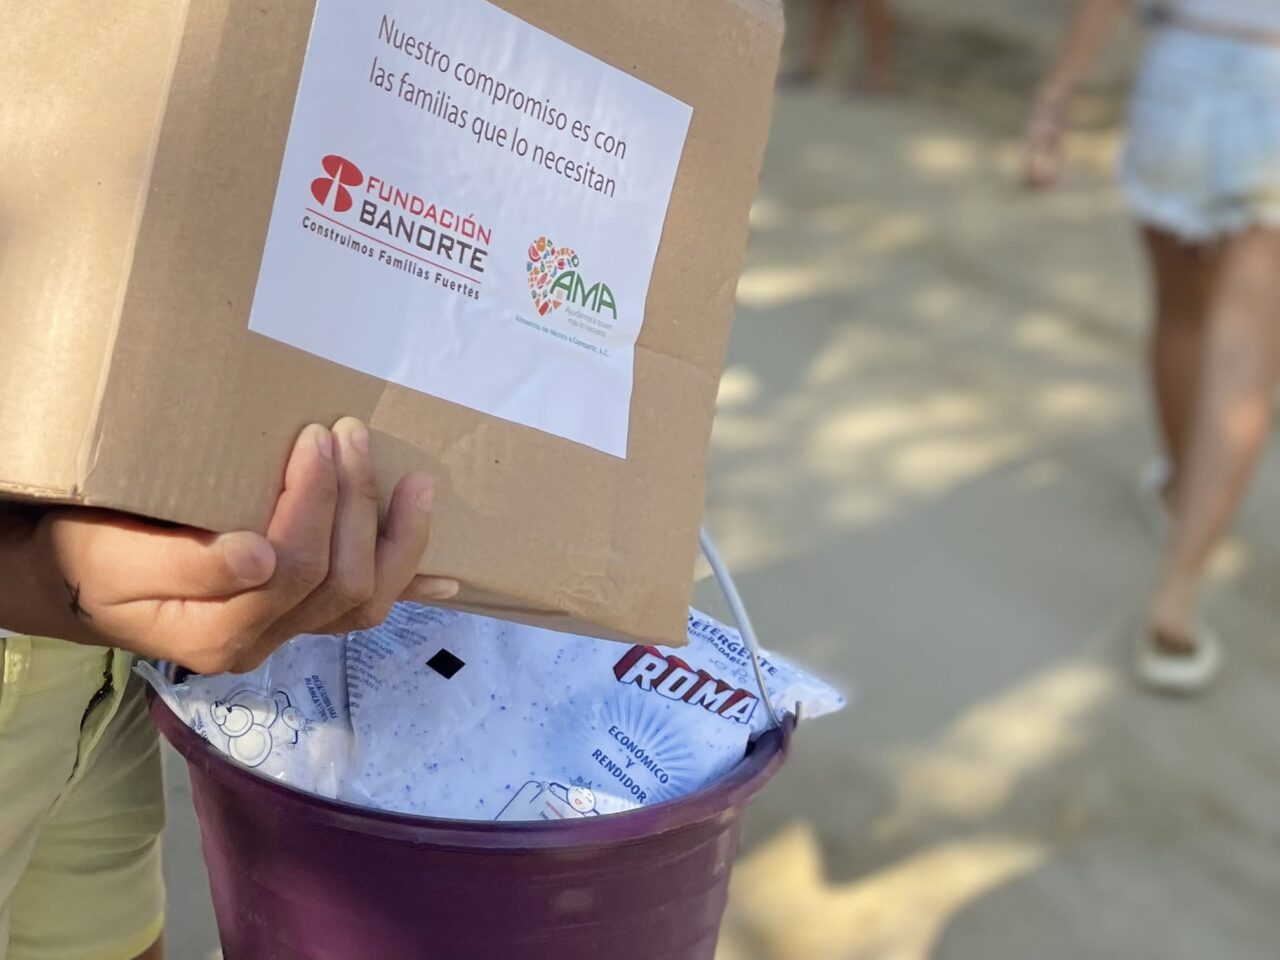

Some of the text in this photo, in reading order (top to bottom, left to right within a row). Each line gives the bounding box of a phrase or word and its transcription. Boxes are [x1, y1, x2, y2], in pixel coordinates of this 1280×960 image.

[378, 14, 627, 159] Nuestro compromiso es con
[369, 56, 616, 198] las familias que lo necesitan
[359, 199, 488, 273] BANORTE
[366, 176, 492, 245] FUNDACIÓN
[302, 216, 480, 300] Construimos Familias Fuertes
[550, 270, 617, 320] AMA
[613, 644, 760, 725] ROMA
[591, 748, 647, 804] RENDIDOR
[608, 725, 669, 784] ECONÓMICO
[625, 758, 635, 769] Y
